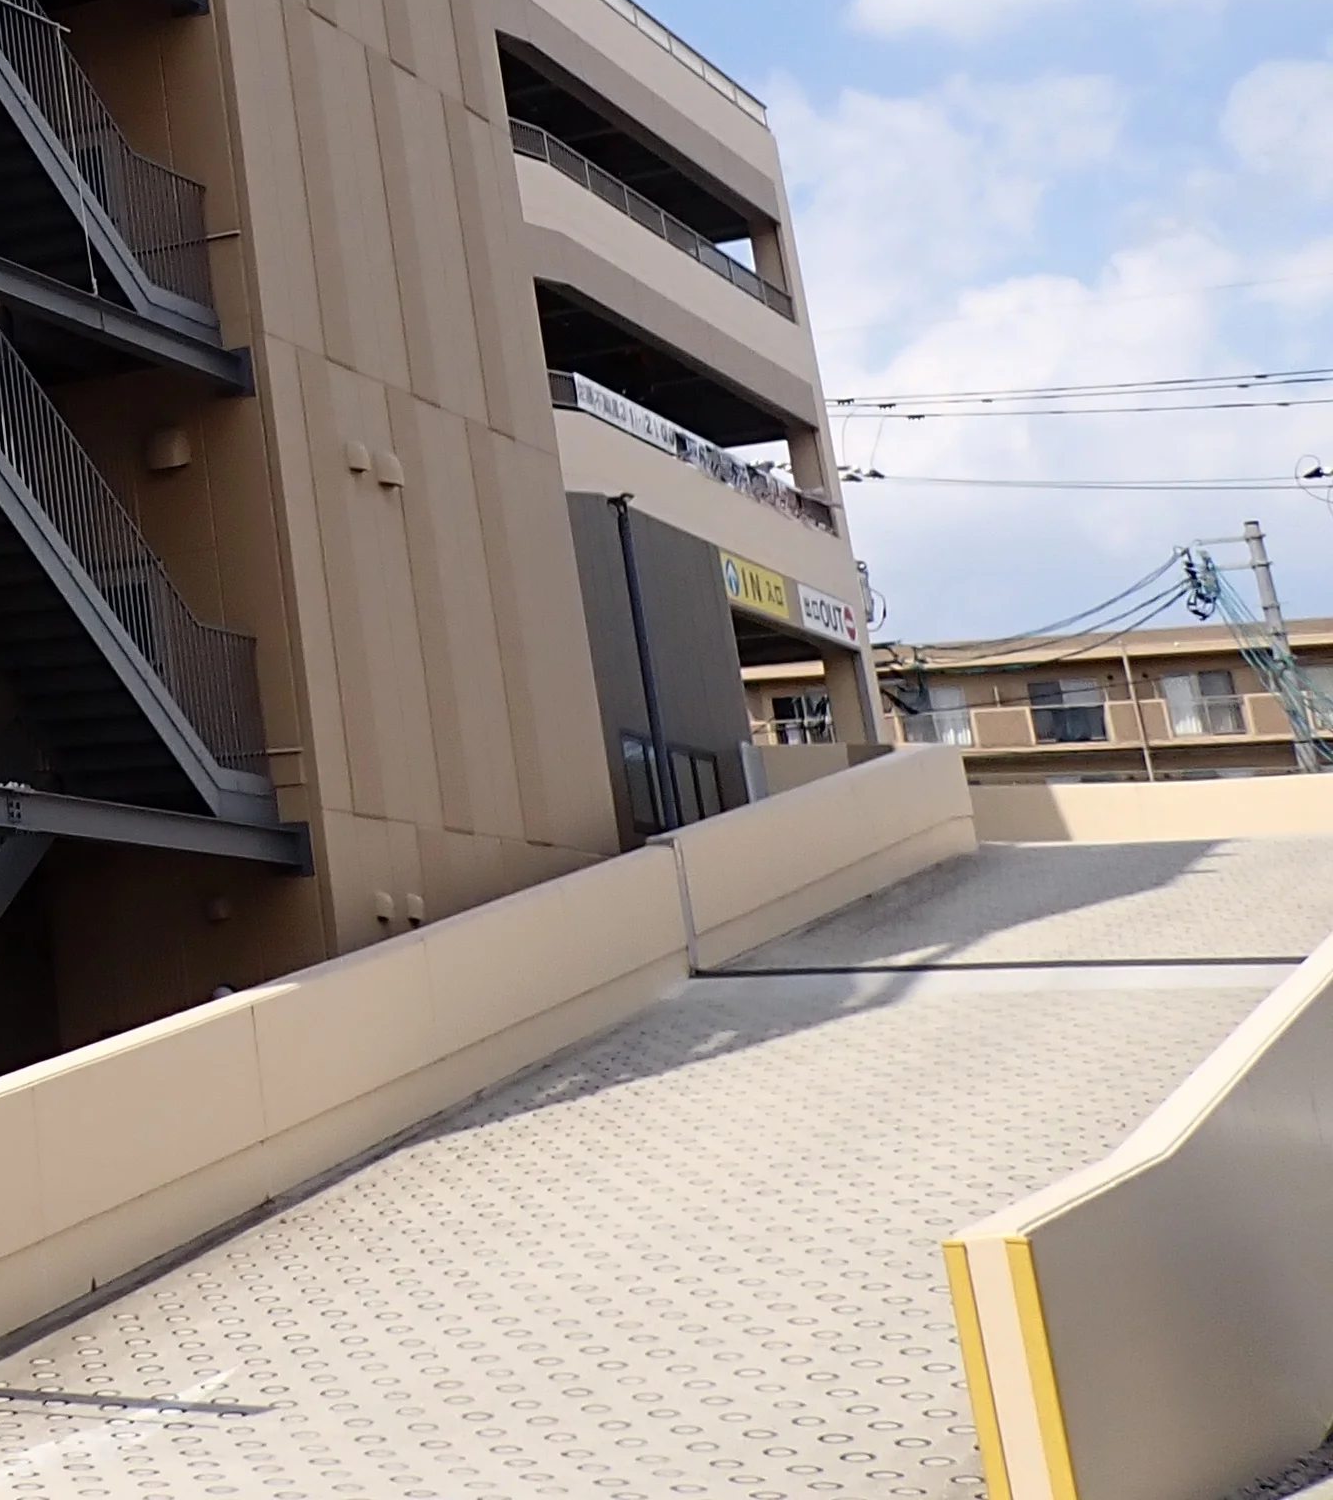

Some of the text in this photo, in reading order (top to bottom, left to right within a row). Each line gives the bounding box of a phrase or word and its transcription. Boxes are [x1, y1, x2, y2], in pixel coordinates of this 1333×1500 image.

[741, 567, 783, 606] IN 入口
[820, 599, 844, 634] OUT
